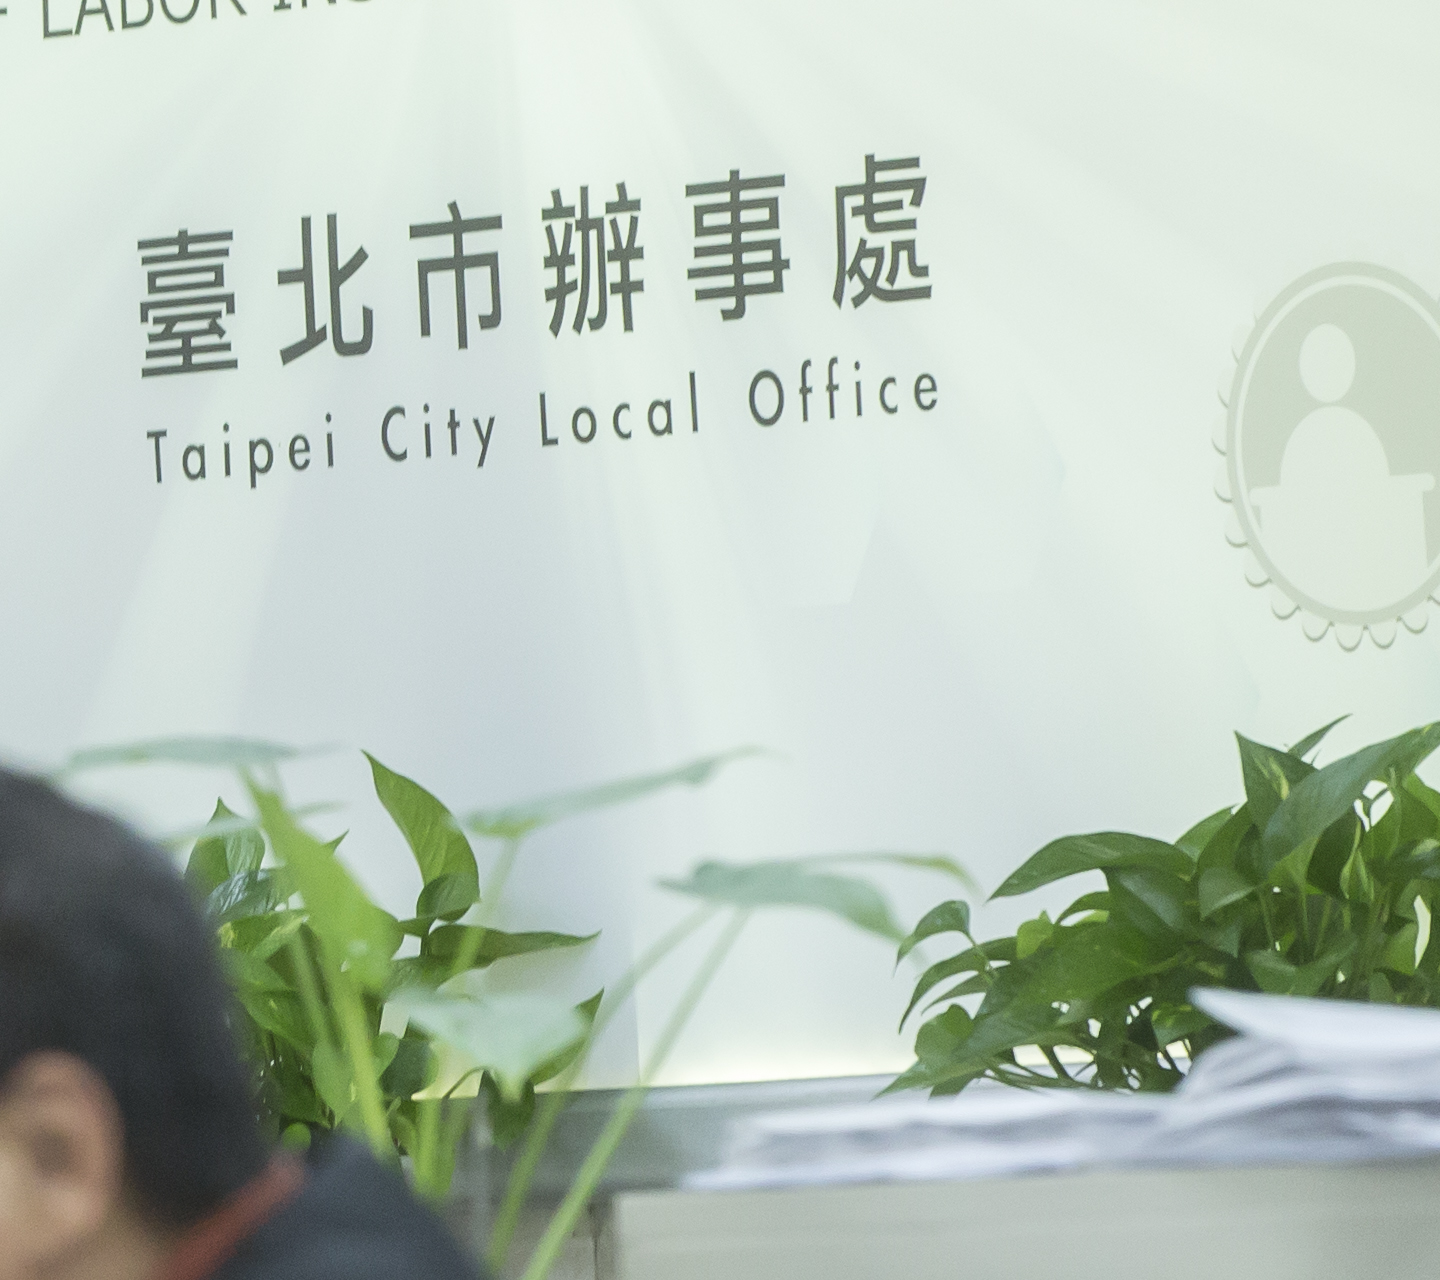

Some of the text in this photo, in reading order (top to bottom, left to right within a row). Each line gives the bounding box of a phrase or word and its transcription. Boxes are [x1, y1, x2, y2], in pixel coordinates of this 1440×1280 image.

[135, 151, 934, 381] 臺北市辦事處
[144, 357, 940, 491] Taipei City Local Office
